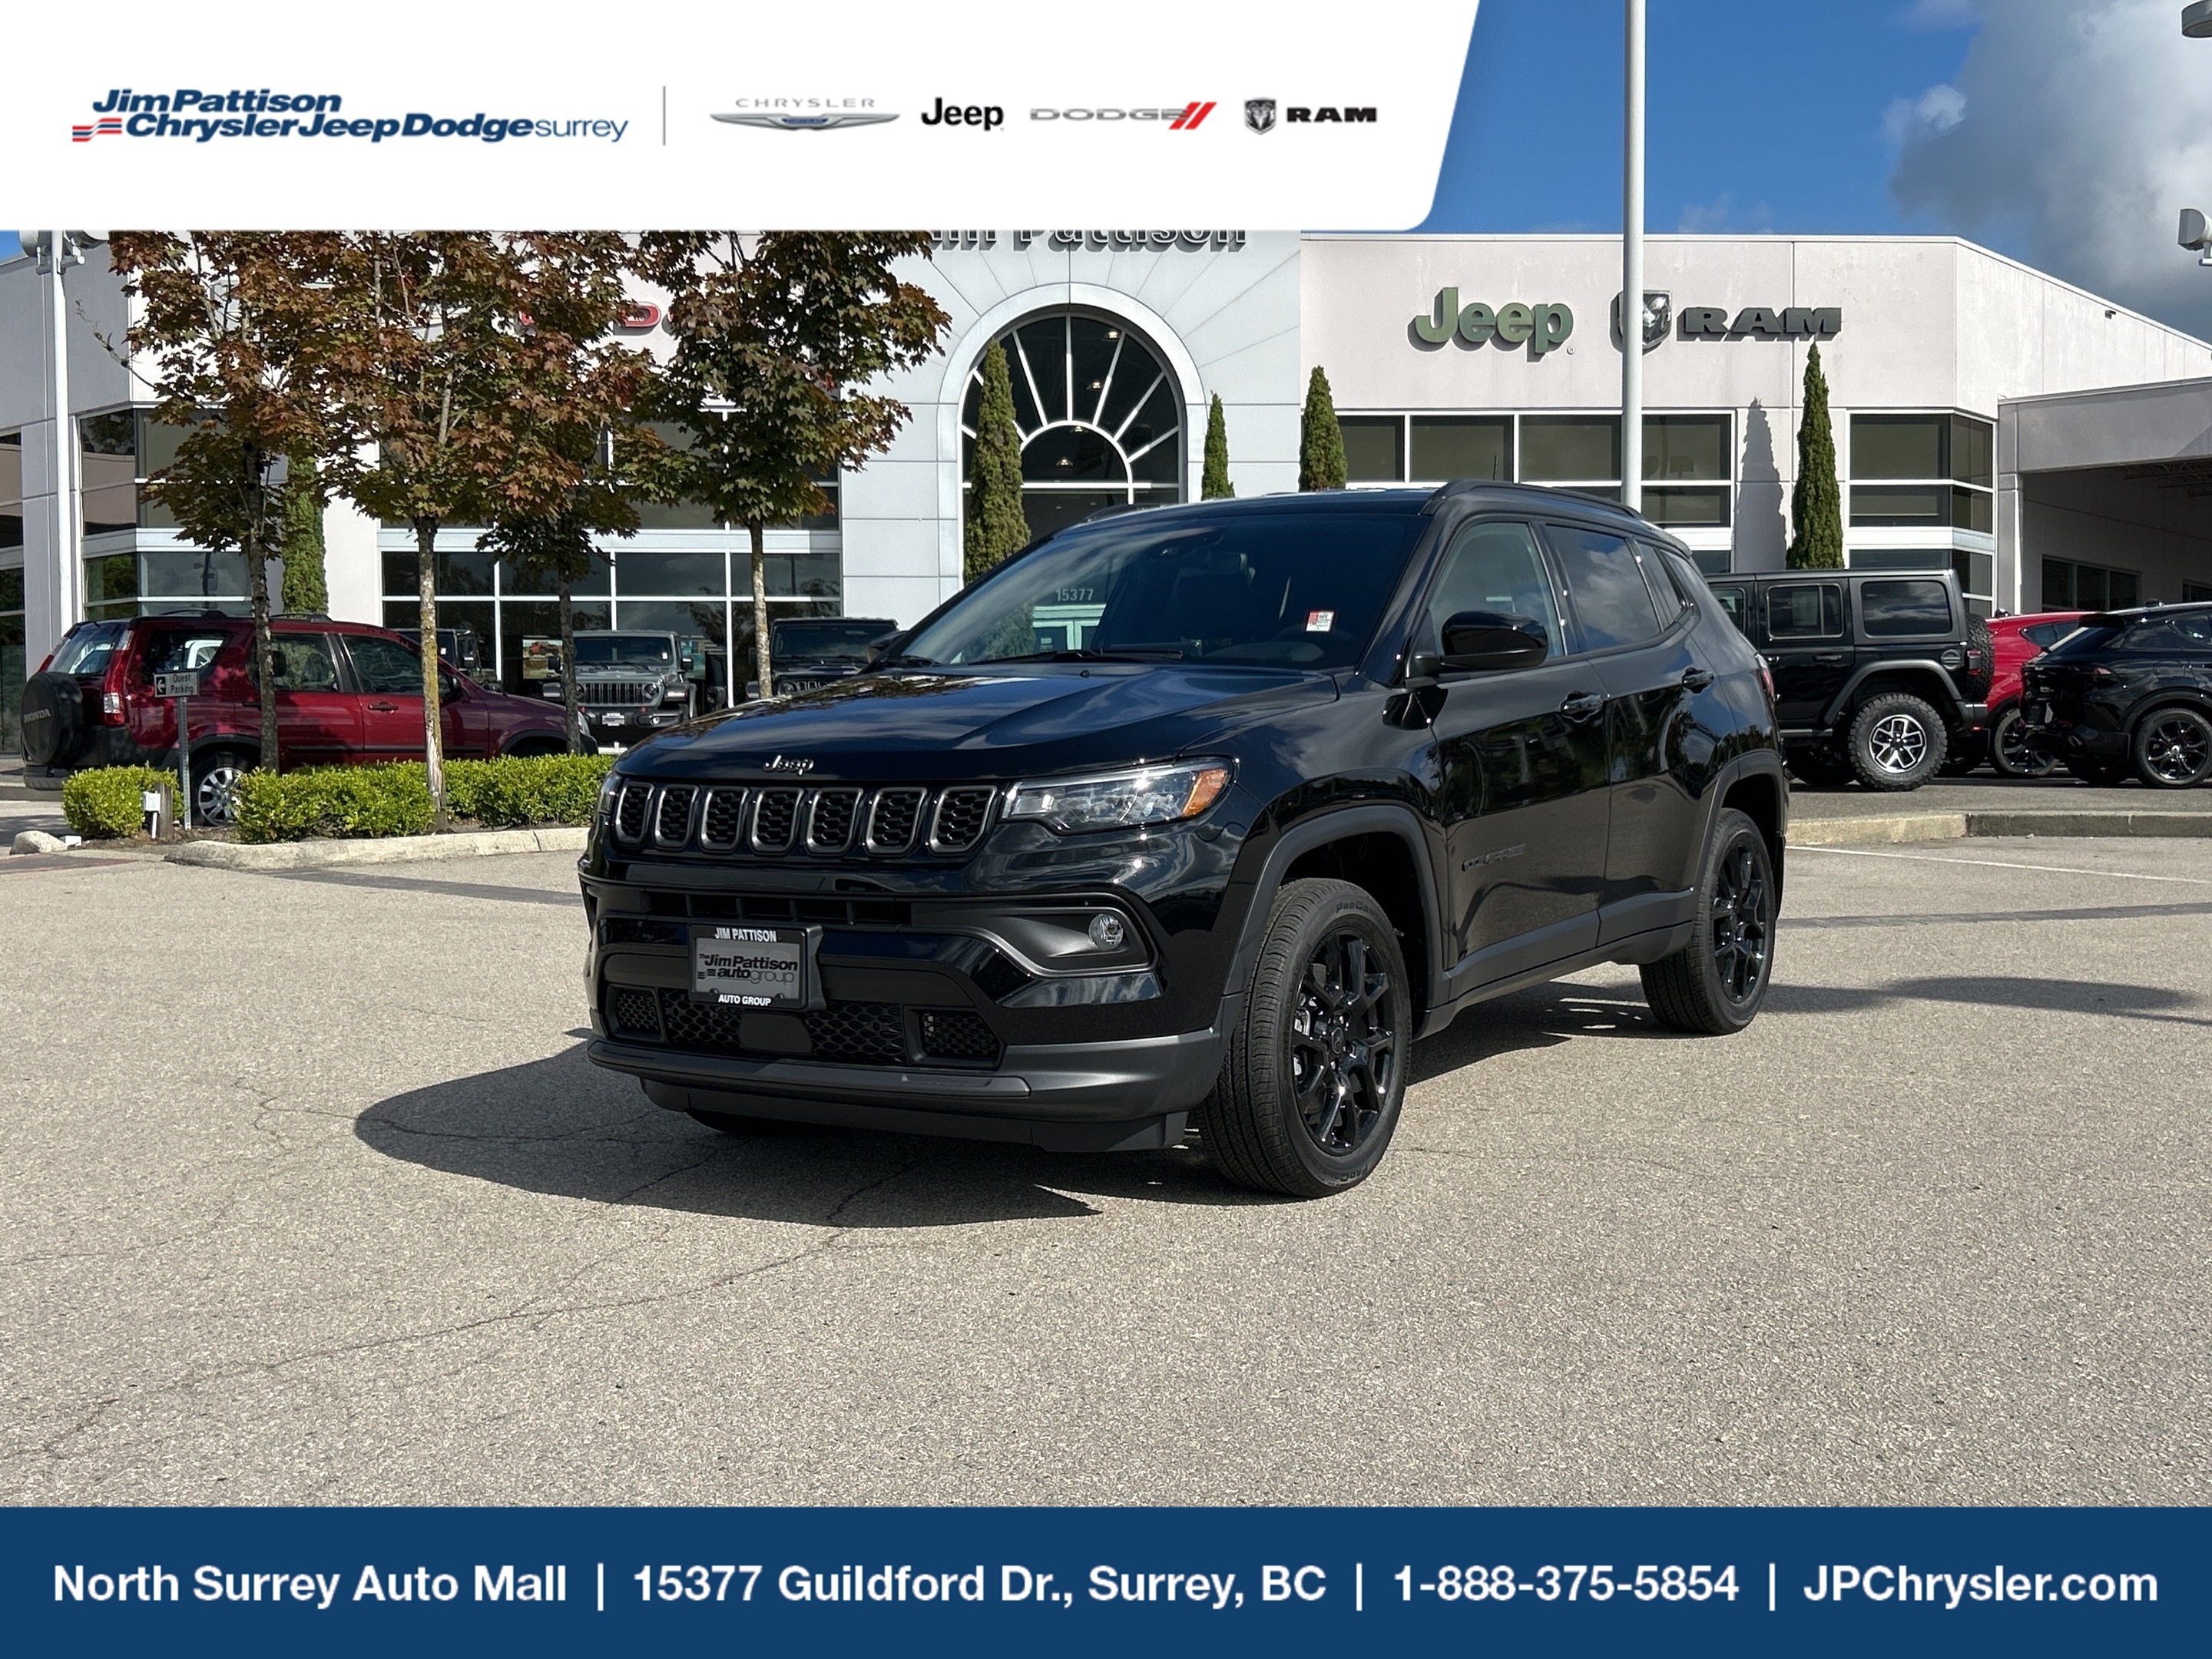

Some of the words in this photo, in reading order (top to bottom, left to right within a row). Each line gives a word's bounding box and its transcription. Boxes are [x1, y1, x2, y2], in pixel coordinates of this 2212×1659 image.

[1415, 286, 1575, 354] Jeep
[1683, 307, 1842, 334] RAM
[1055, 588, 1094, 602] 15377
[173, 674, 191, 683] Guest
[171, 684, 194, 695] Parking
[24, 708, 51, 723] HONDA
[763, 755, 814, 776] Jeep
[715, 927, 731, 939] JIM
[732, 929, 777, 942] PATTISON
[718, 994, 740, 1004] AUTO
[742, 996, 772, 1006] GROUP
